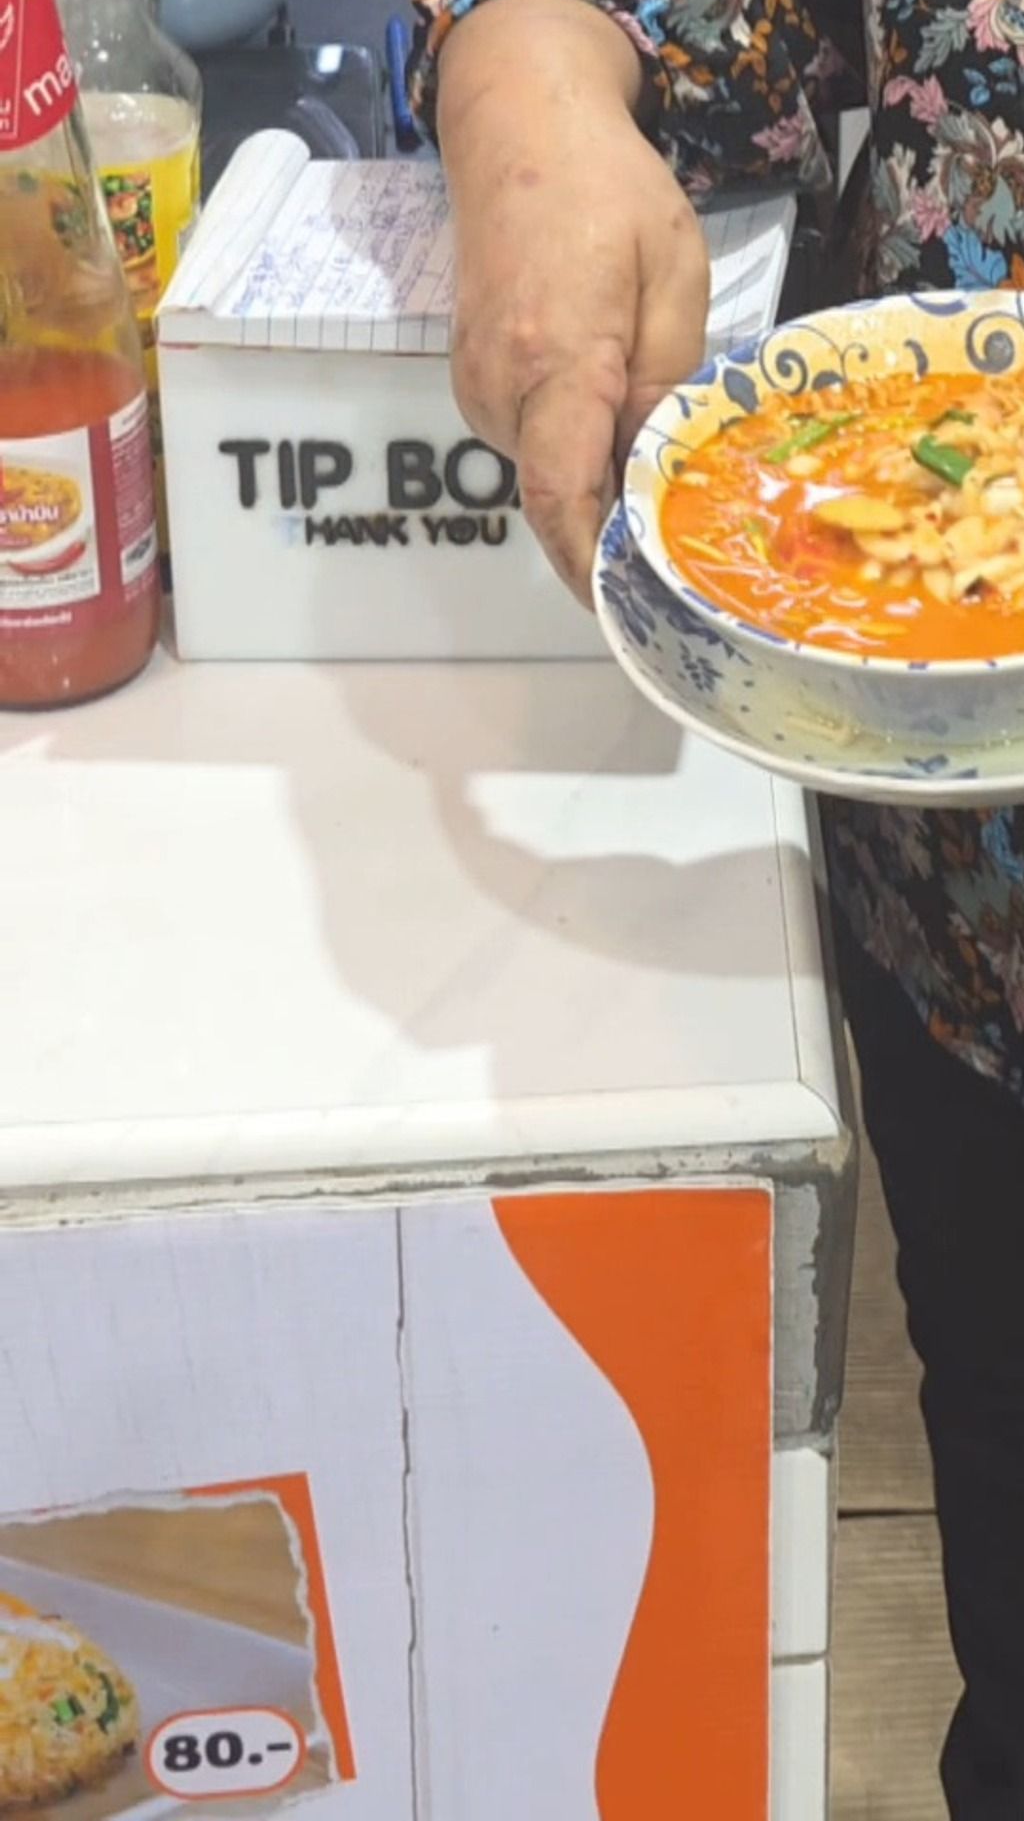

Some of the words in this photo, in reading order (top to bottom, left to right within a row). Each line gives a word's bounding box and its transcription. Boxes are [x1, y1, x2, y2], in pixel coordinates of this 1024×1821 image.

[218, 438, 353, 509] TIP
[386, 438, 521, 509] BO
[423, 516, 508, 546] YOU
[163, 1731, 292, 1772] 80.-
